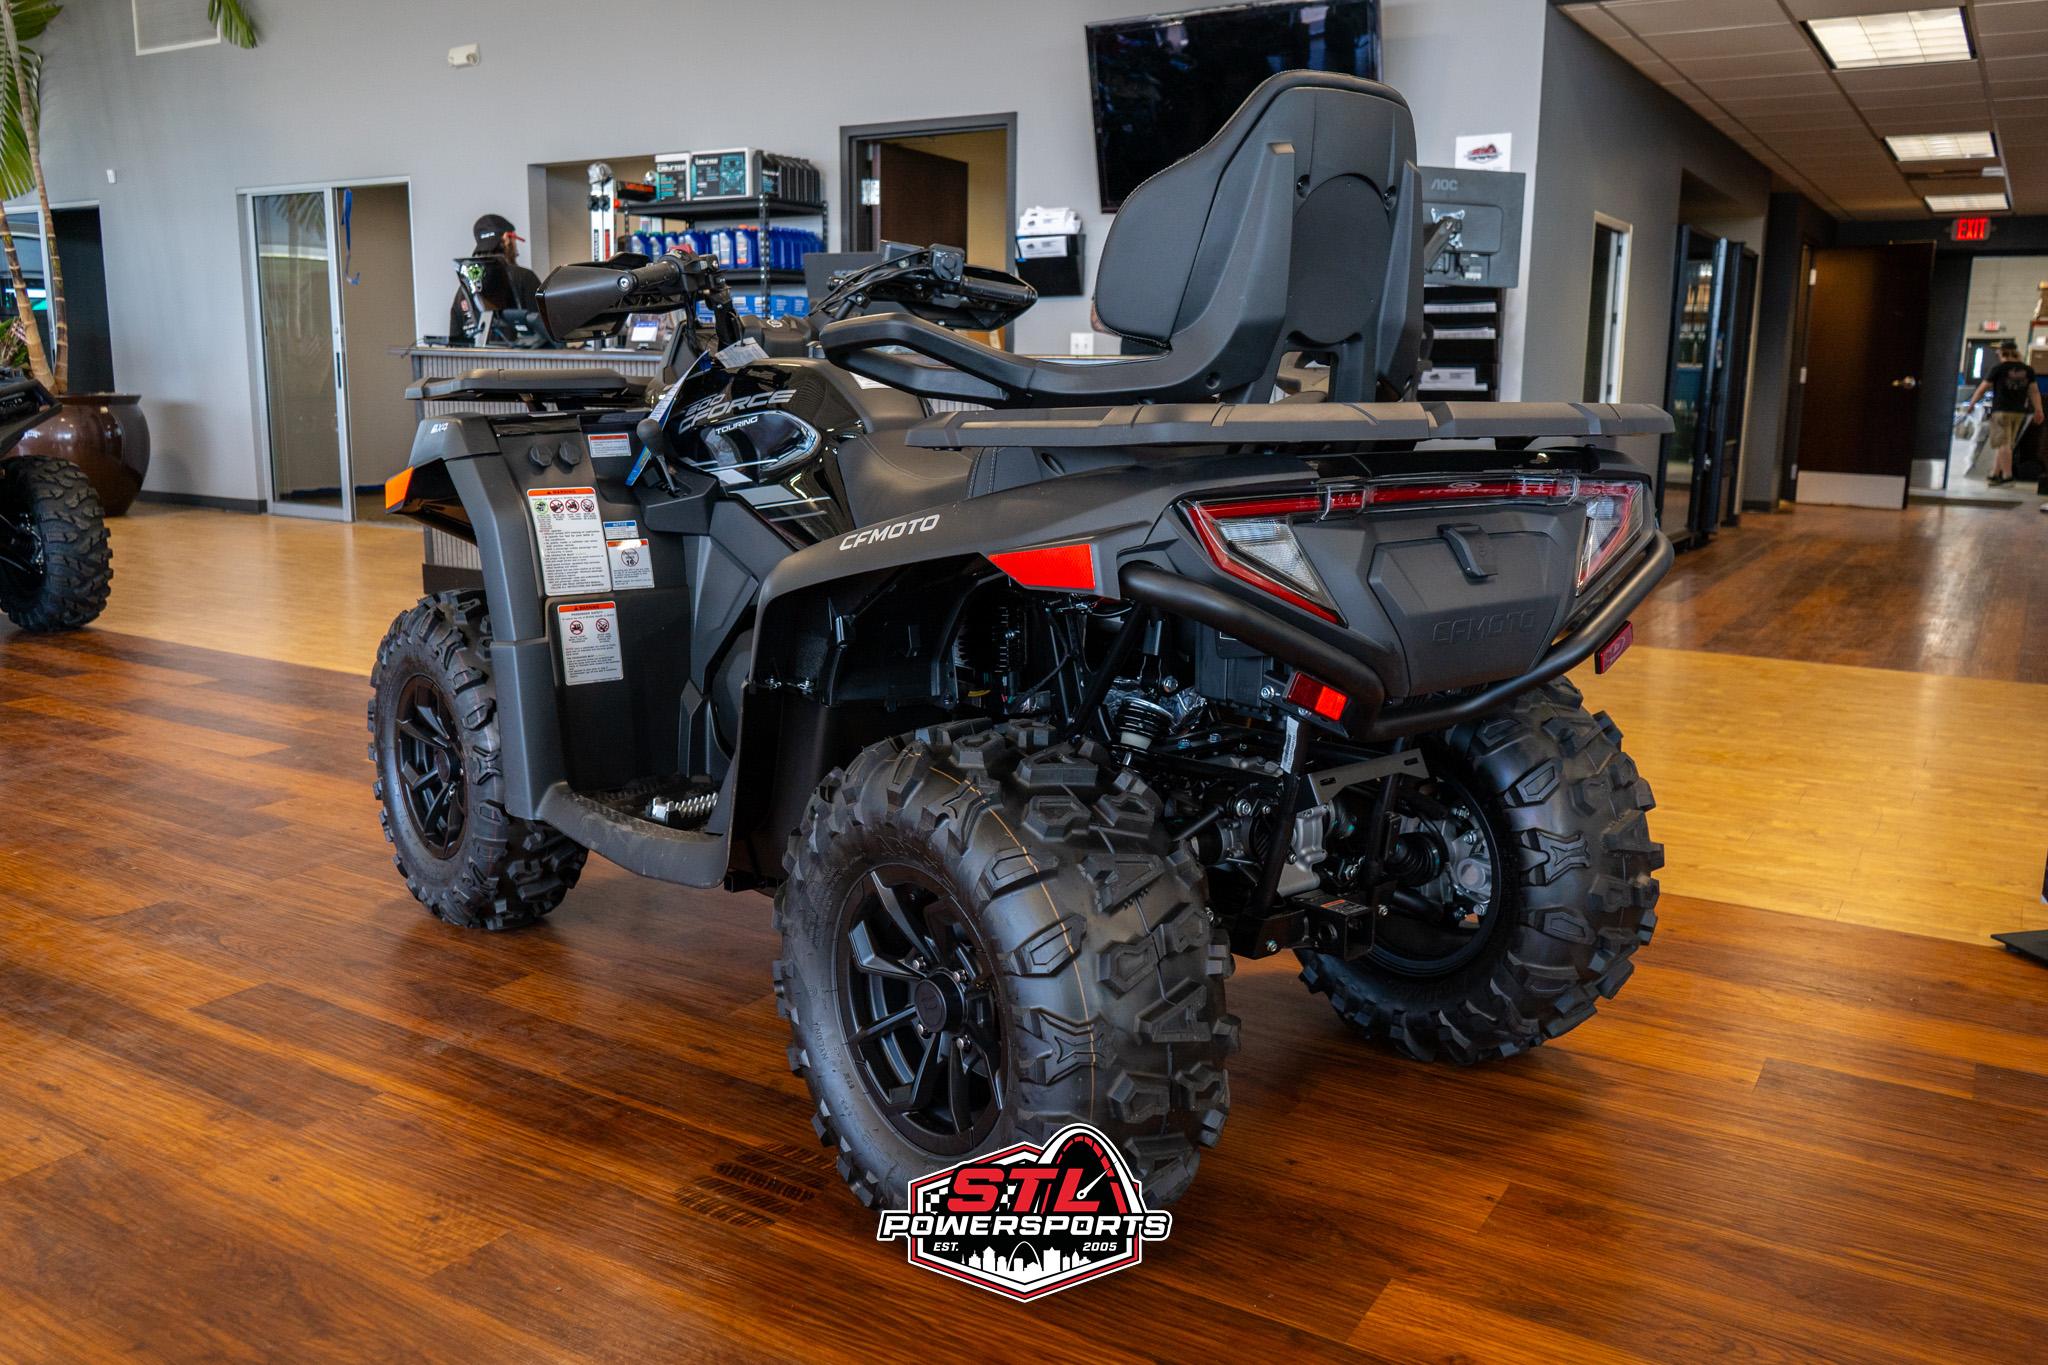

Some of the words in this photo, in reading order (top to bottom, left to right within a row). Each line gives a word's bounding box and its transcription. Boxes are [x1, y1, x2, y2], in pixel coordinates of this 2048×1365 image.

[1431, 179, 1458, 191] AOC
[1957, 218, 1987, 240] EXIT
[679, 389, 797, 435] CFORCE
[685, 394, 725, 416] 500
[715, 416, 758, 435] TOURING
[839, 514, 940, 550] CFMOTO
[1433, 609, 1536, 644] CFMOTO
